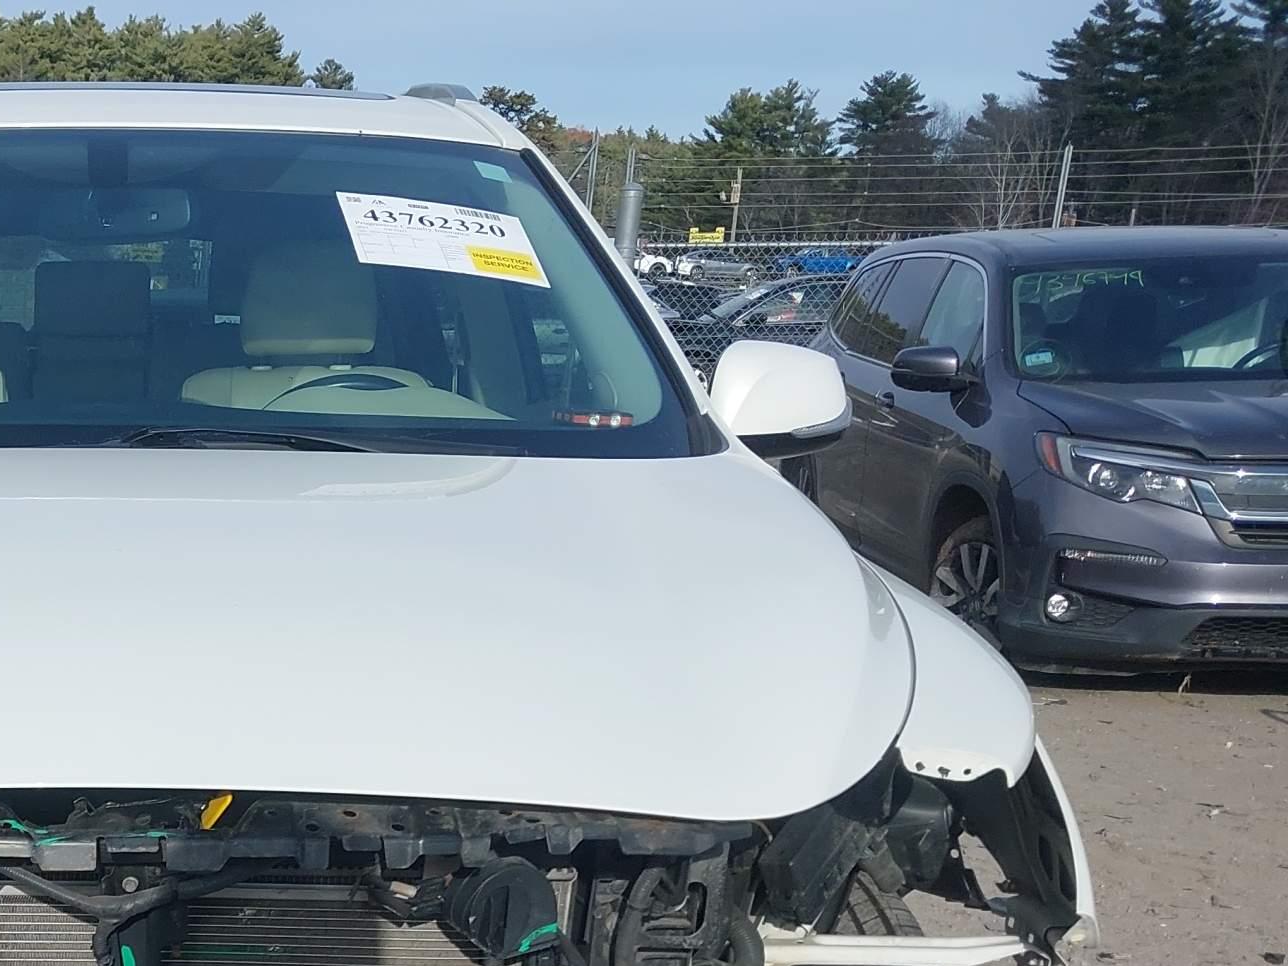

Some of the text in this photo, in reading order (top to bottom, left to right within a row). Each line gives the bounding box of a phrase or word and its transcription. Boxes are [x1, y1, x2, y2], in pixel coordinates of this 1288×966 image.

[363, 208, 506, 239] 43762320
[471, 251, 534, 268] INSPECTION
[483, 260, 529, 273] SERVICE
